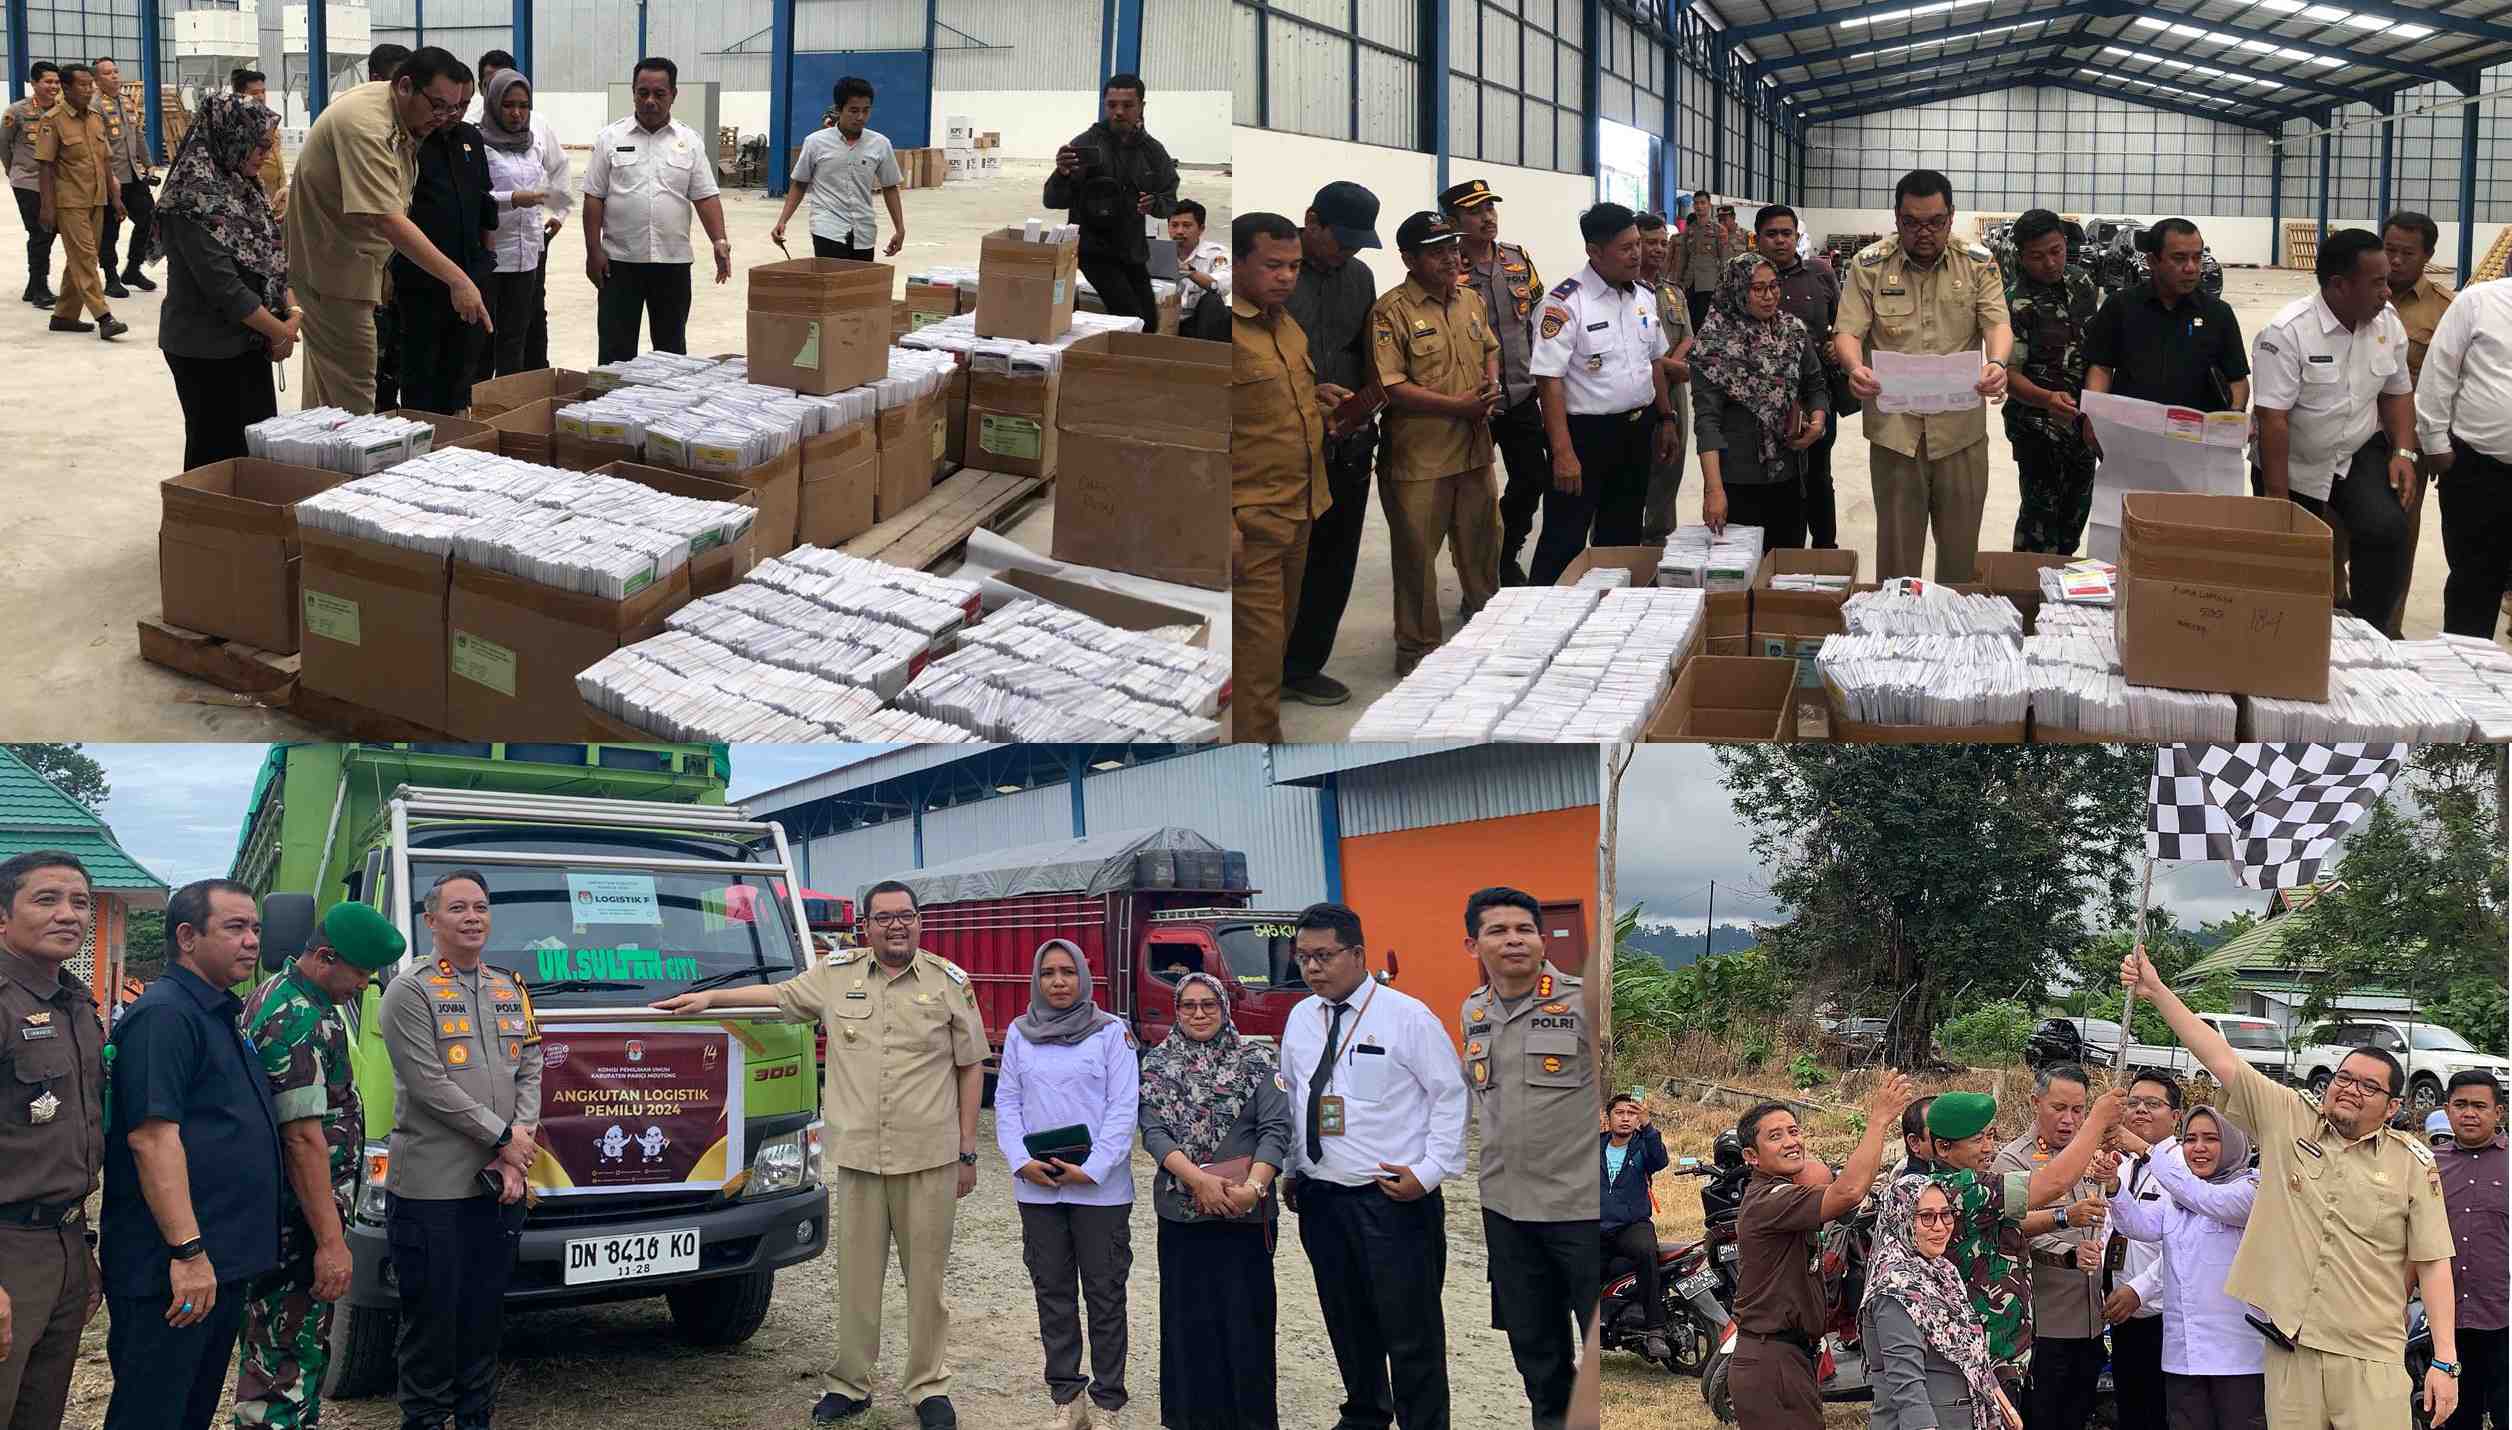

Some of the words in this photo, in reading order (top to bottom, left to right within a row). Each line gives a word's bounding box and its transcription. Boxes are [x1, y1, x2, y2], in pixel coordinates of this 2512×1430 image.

[595, 895, 642, 904] LOGISTIK
[1254, 924, 1279, 937] 545
[437, 1003, 466, 1014] JOVAN
[495, 1003, 522, 1013] POLRI
[1531, 1018, 1574, 1029] POLRI
[552, 1090, 640, 1103] ANGKUTAN
[644, 1088, 710, 1101] LOGISTIK
[584, 1104, 643, 1117] PEMILU
[647, 1103, 682, 1116] 2024
[570, 1243, 597, 1269] DN
[606, 1236, 659, 1264] 8416
